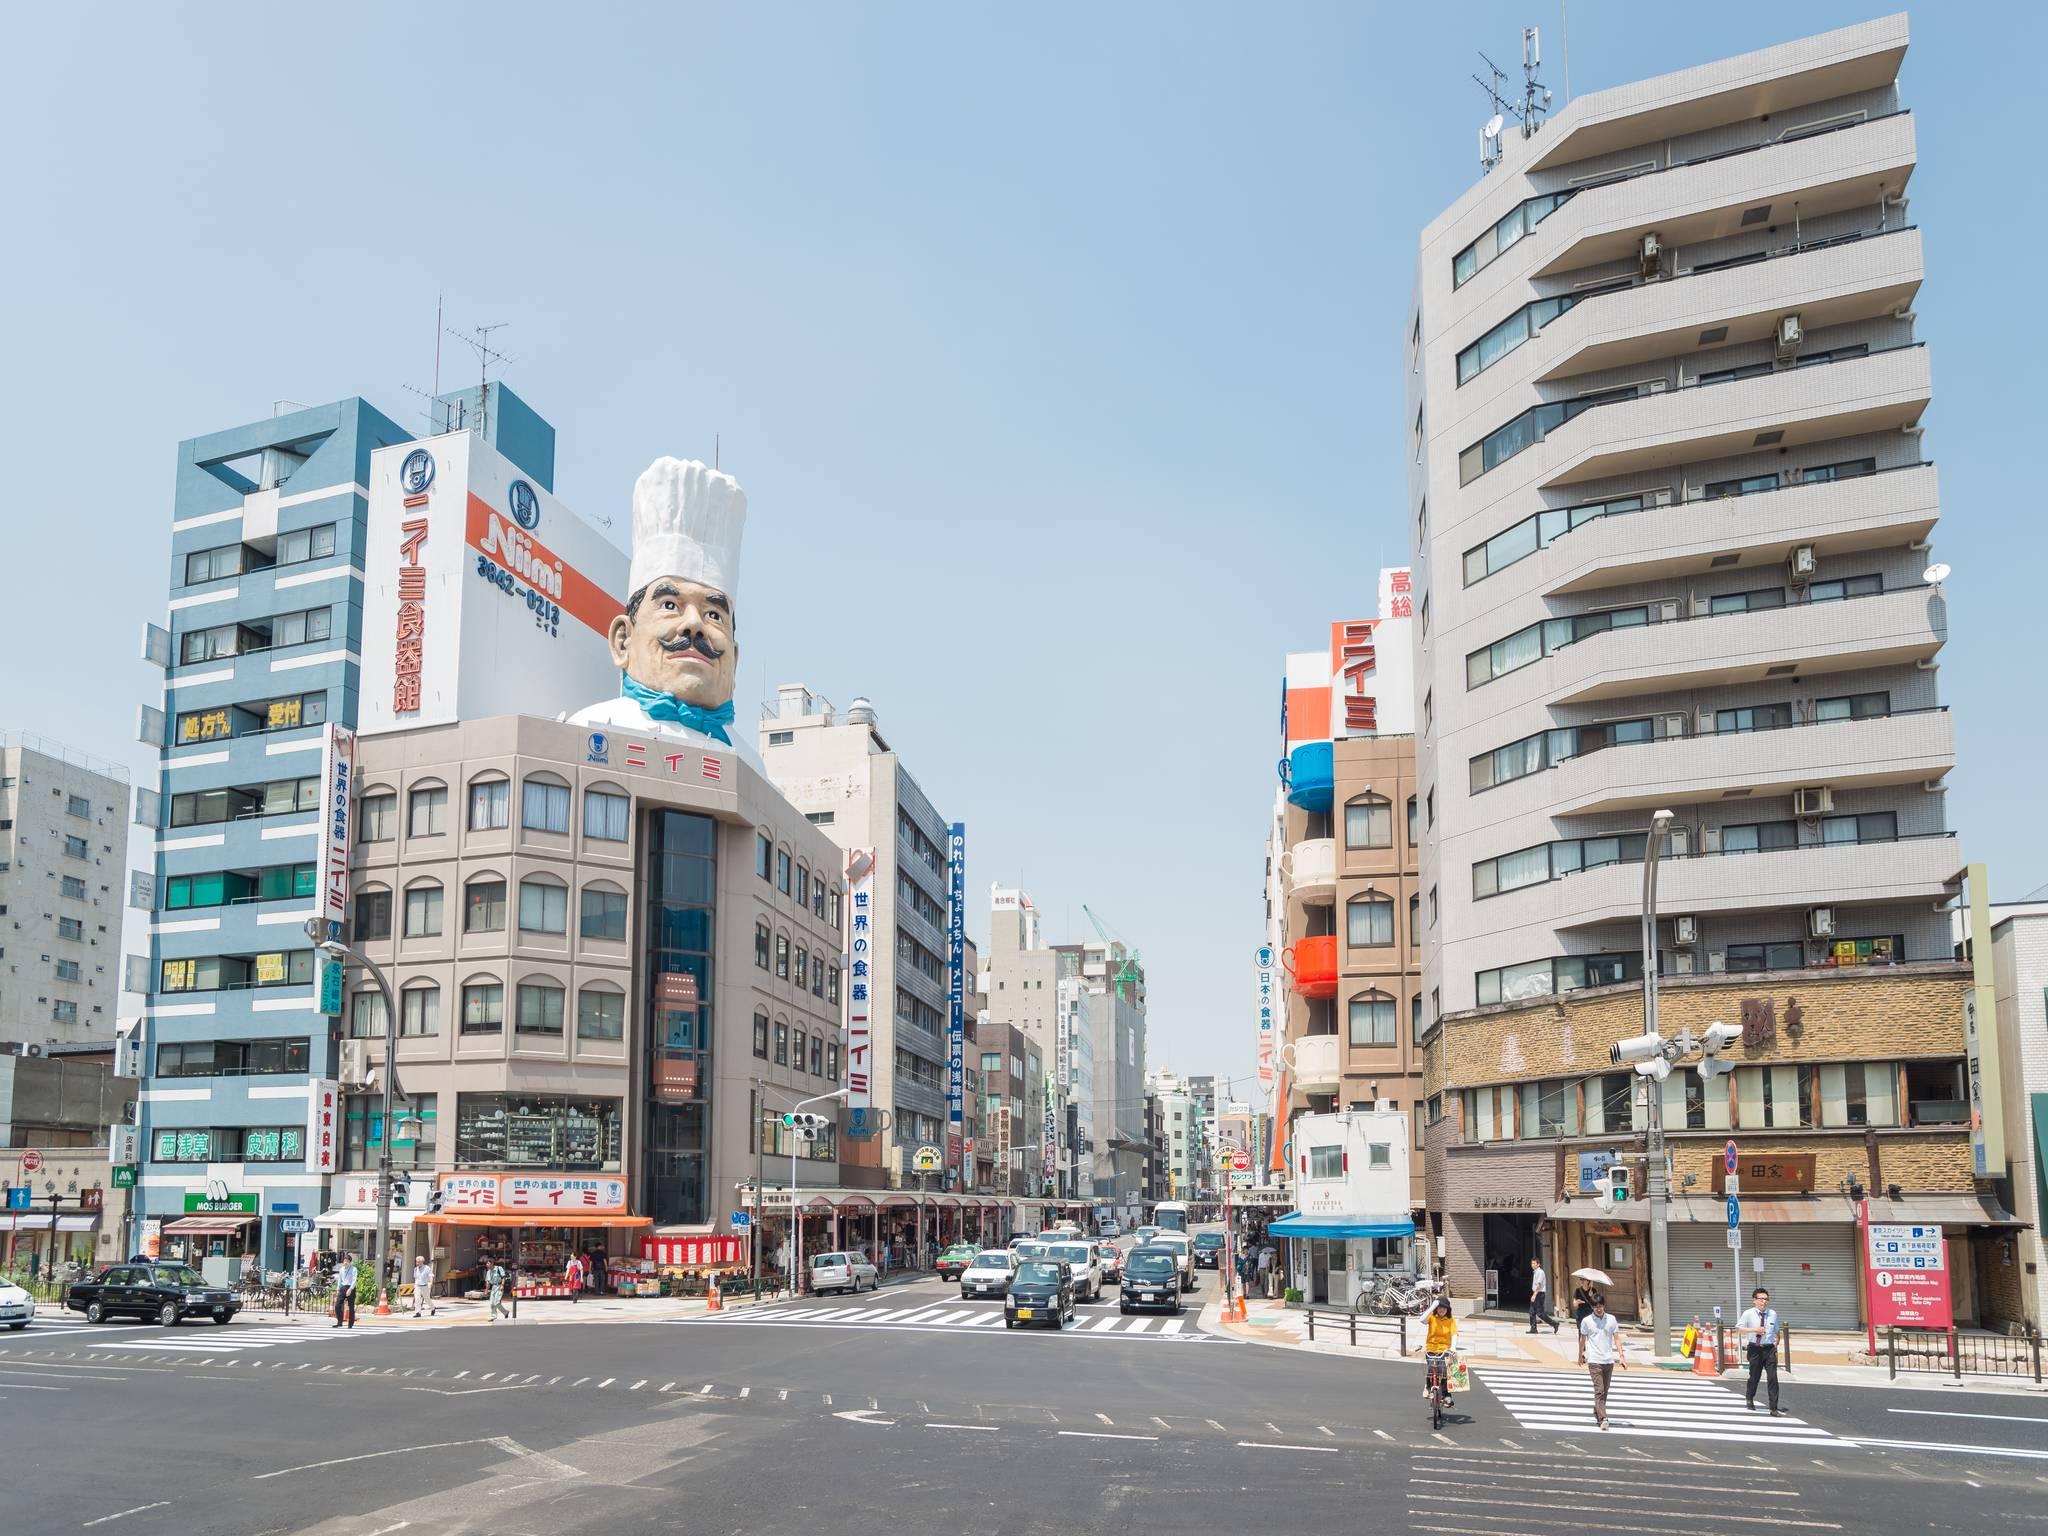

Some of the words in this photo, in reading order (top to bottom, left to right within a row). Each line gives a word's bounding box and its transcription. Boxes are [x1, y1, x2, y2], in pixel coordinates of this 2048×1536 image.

[480, 513, 563, 600] Niimi
[393, 493, 429, 713] ニイミ食器館
[477, 555, 561, 626] 3842-0213
[1390, 571, 1412, 617] 高総
[1343, 624, 1377, 729] ニイミ
[184, 711, 231, 739] 処方せん
[268, 700, 301, 726] 受付
[587, 754, 609, 764] Niimi
[626, 743, 722, 781] ニイミ
[333, 761, 349, 841] 世界の食器
[330, 846, 346, 911] ニイミ
[853, 892, 869, 1001] 世界の食器
[1260, 972, 1271, 1030] 日本の食器
[850, 1015, 869, 1094] ニイミ
[1259, 1032, 1273, 1081] ニイミ
[160, 1134, 209, 1158] 西浅草
[246, 1131, 298, 1157] 皮膚科
[196, 1202, 214, 1211] MOS
[214, 1203, 243, 1211] BURGER
[457, 1189, 495, 1205] ニイミ
[458, 1180, 495, 1188] 世界の食器
[513, 1190, 598, 1205] ニイミ
[514, 1180, 598, 1189] 世界の食器・調理器具
[1729, 1203, 1736, 1222] P
